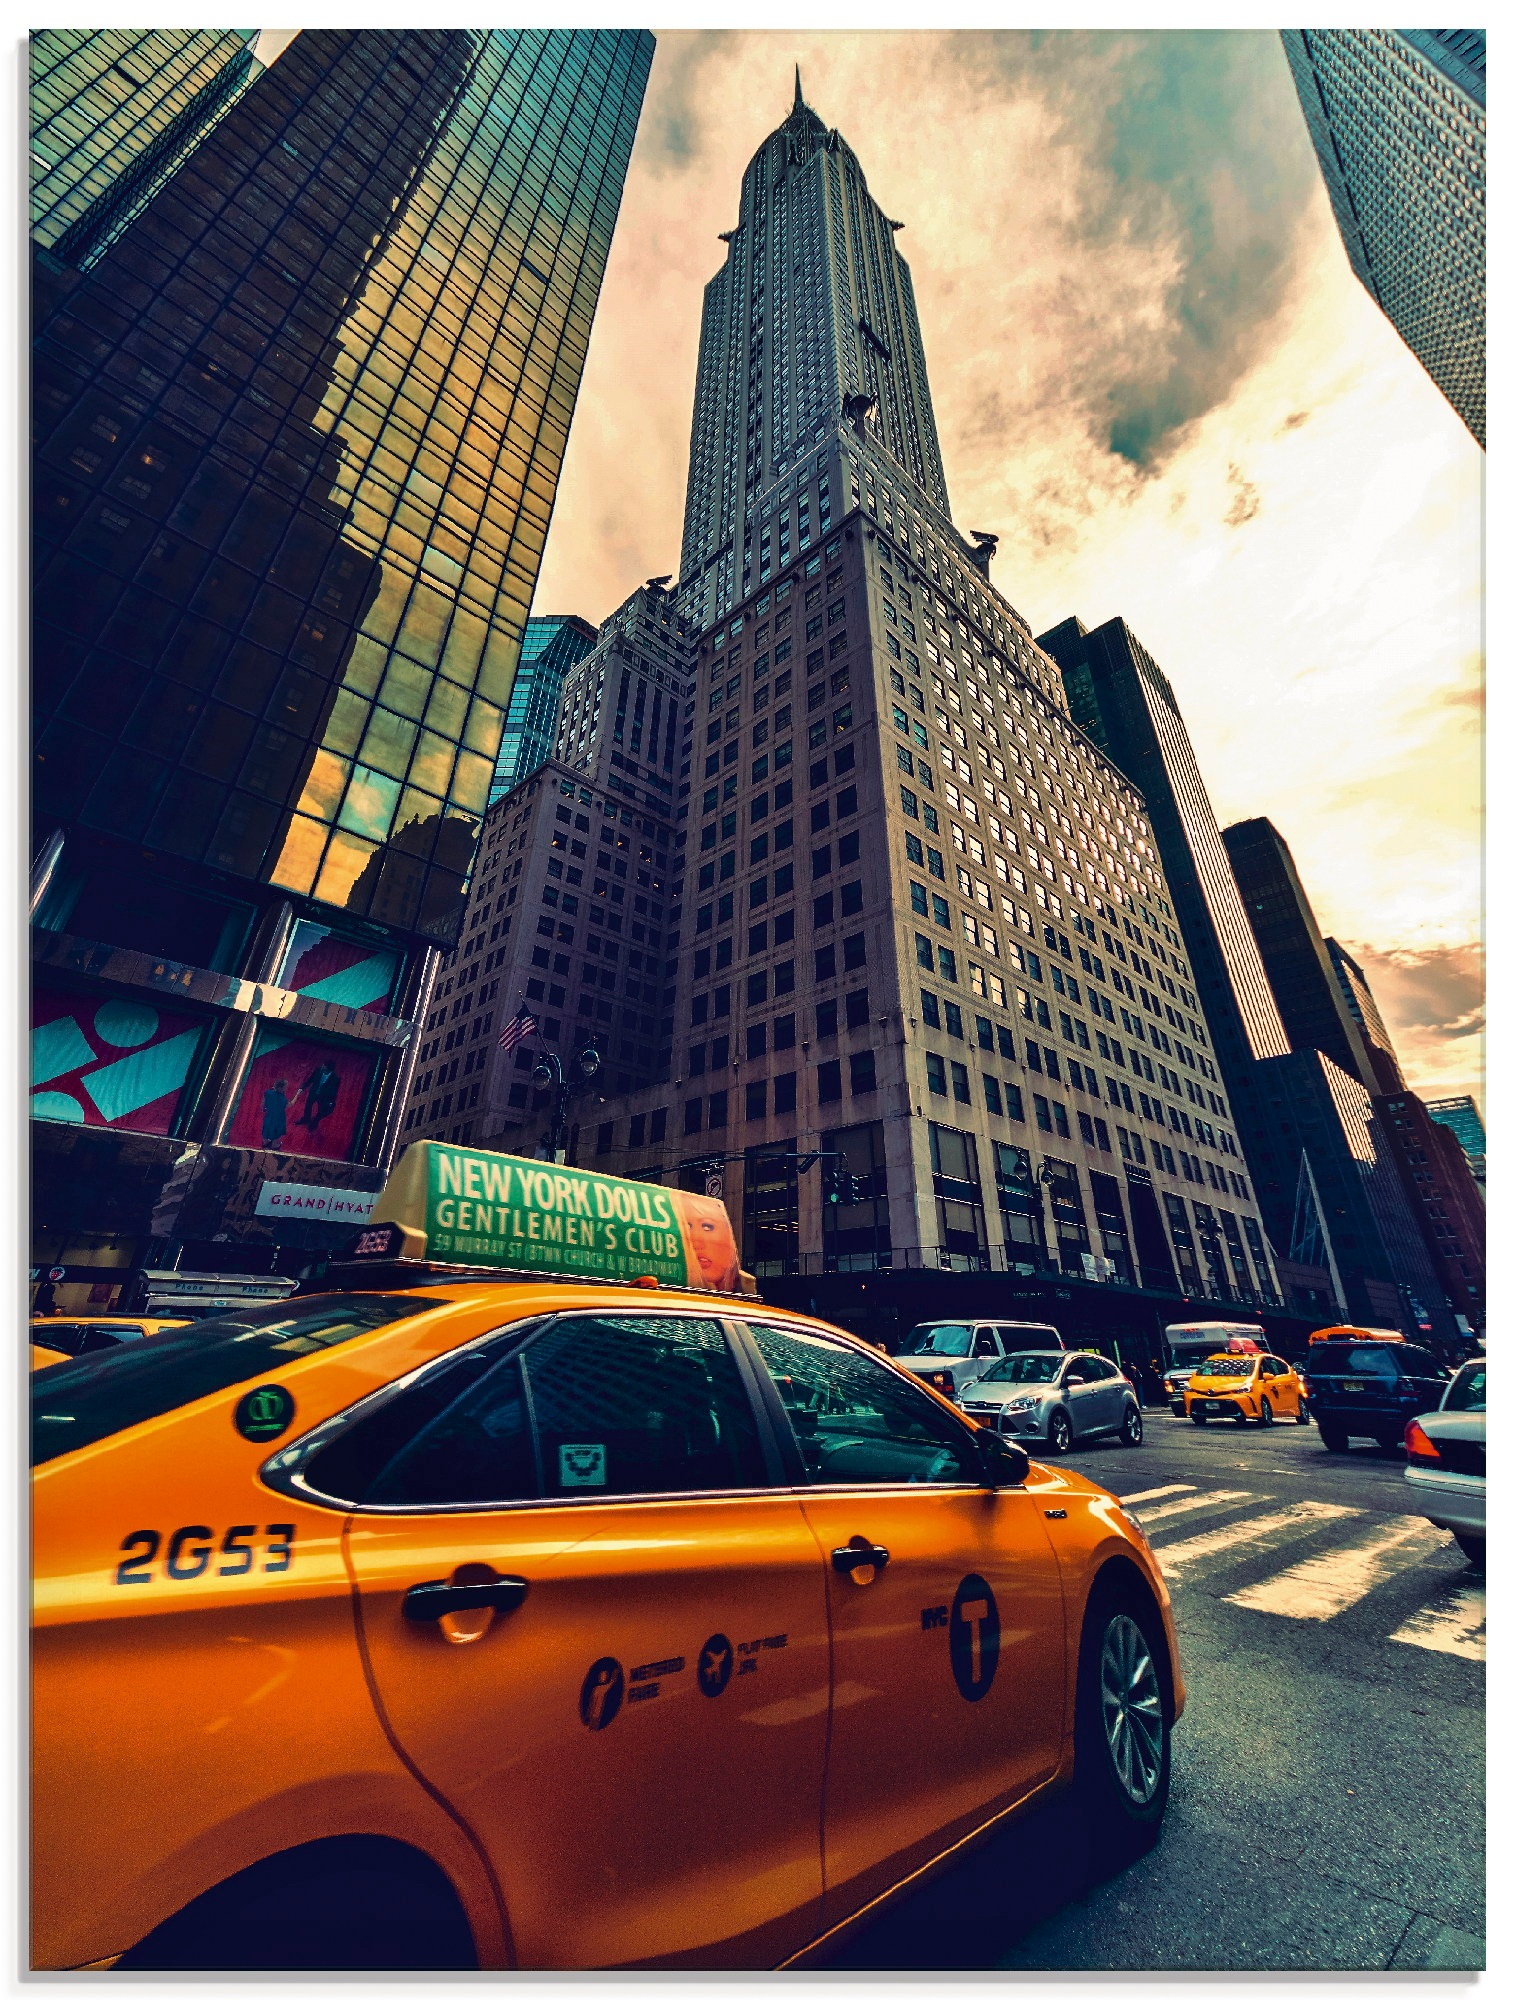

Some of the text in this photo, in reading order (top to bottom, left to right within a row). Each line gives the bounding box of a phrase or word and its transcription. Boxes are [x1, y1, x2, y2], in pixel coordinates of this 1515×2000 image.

[271, 1194, 326, 1209] GRAND
[438, 1153, 671, 1229] NEW YORK DOLLS
[436, 1199, 678, 1258] GENTLEMEN'S CLUB
[454, 1235, 506, 1256] MURRAY
[563, 1249, 605, 1268] CHURCH
[175, 1283, 269, 1294] Phone Phone
[115, 1523, 297, 1585] 2G53
[921, 1605, 948, 1630] NYC
